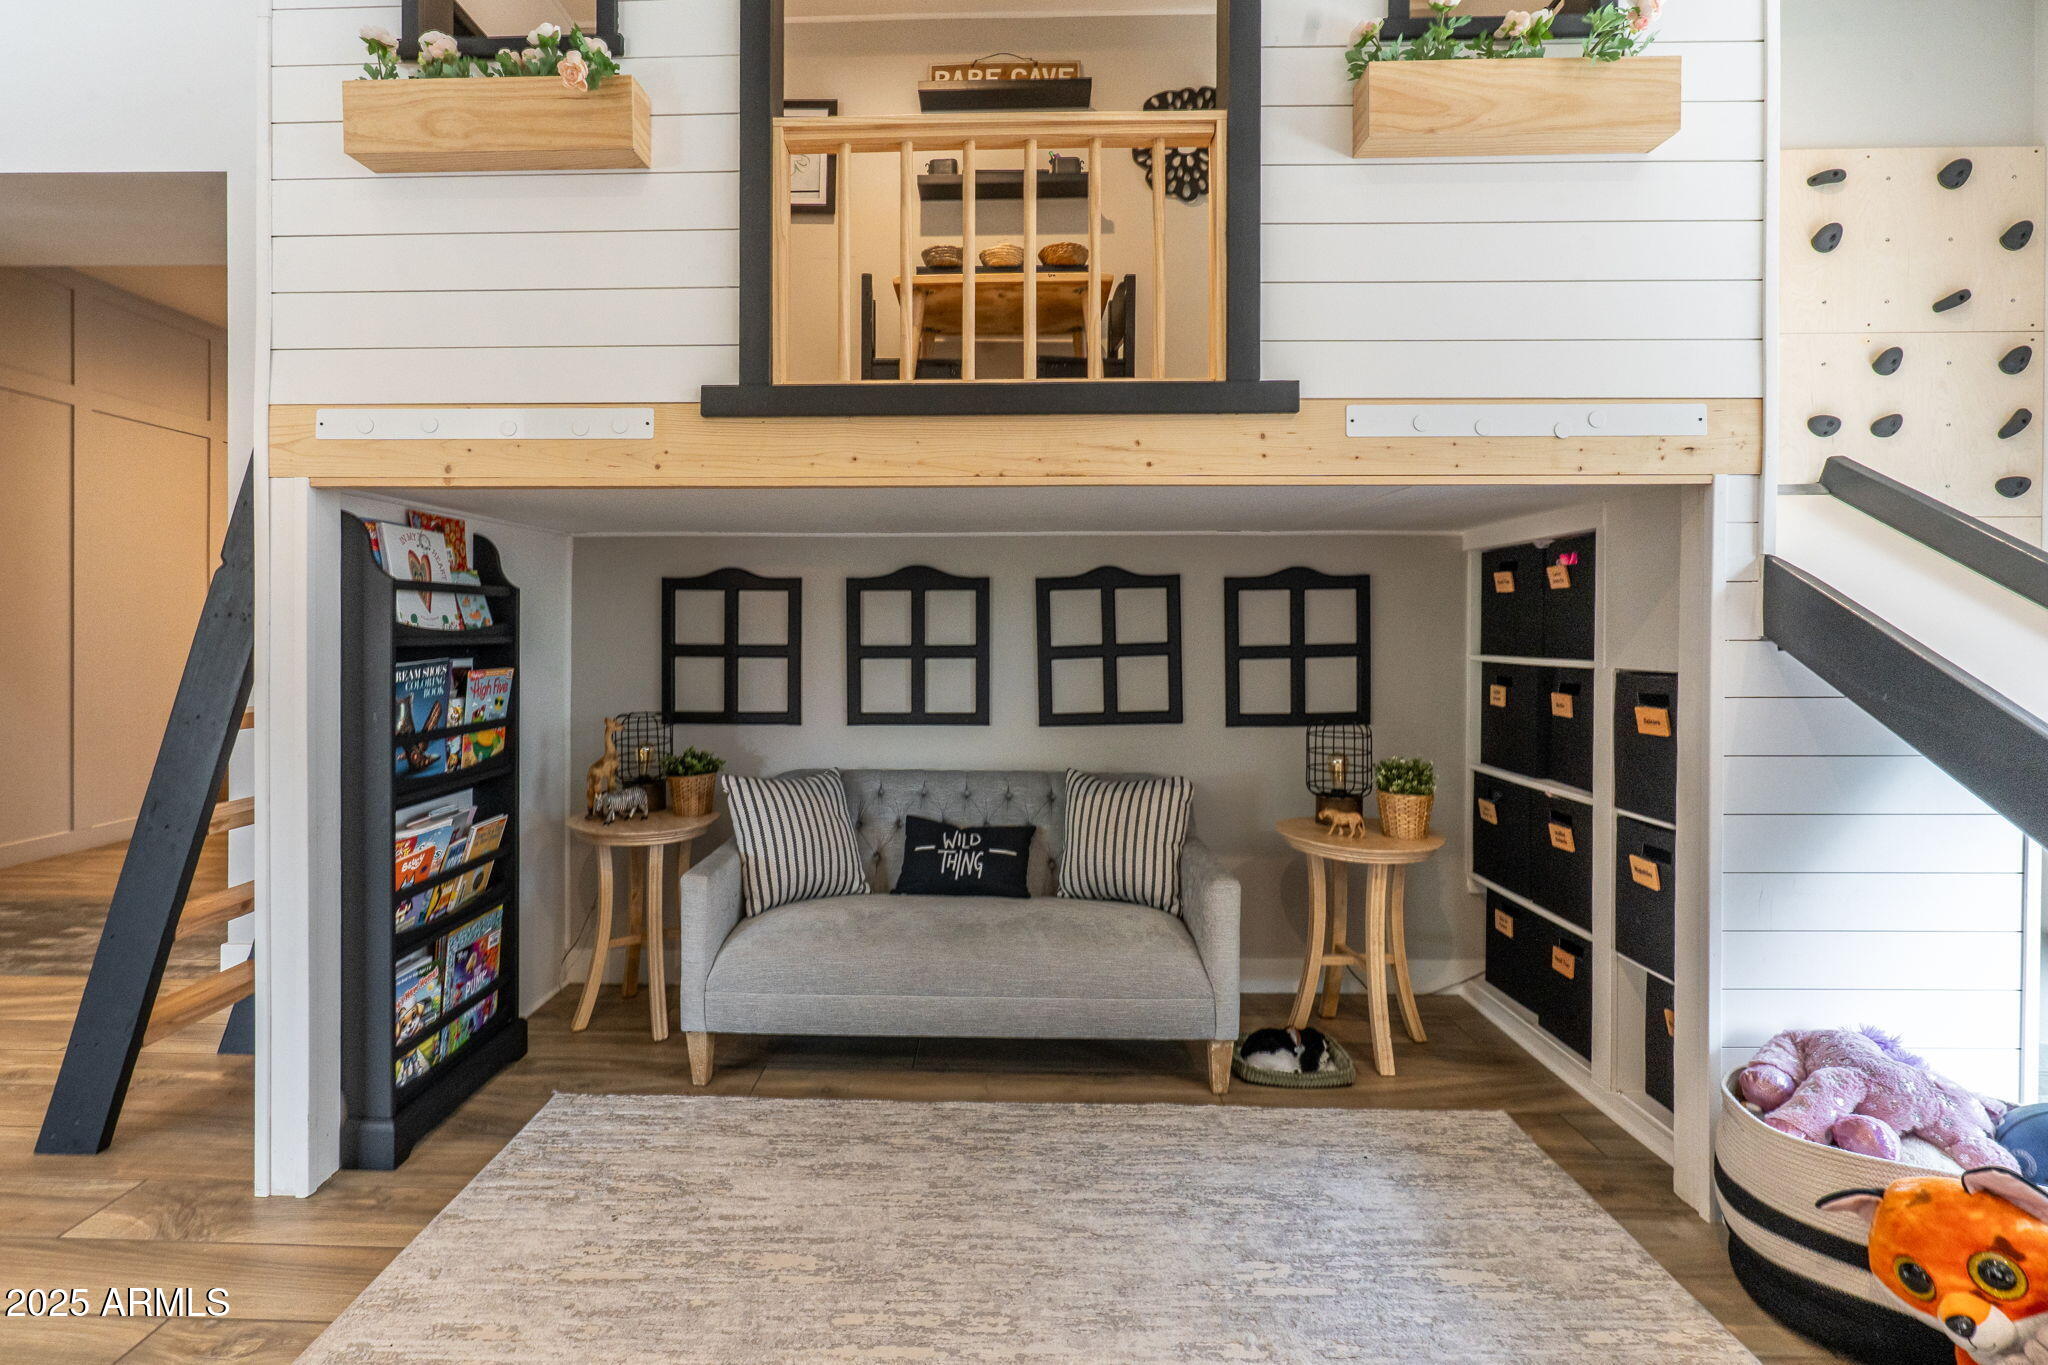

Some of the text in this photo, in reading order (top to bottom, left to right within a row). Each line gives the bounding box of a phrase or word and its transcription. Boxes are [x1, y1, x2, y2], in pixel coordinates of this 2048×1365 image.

[470, 677, 509, 701] High Five
[943, 830, 982, 850] WILD
[938, 849, 984, 881] THING
